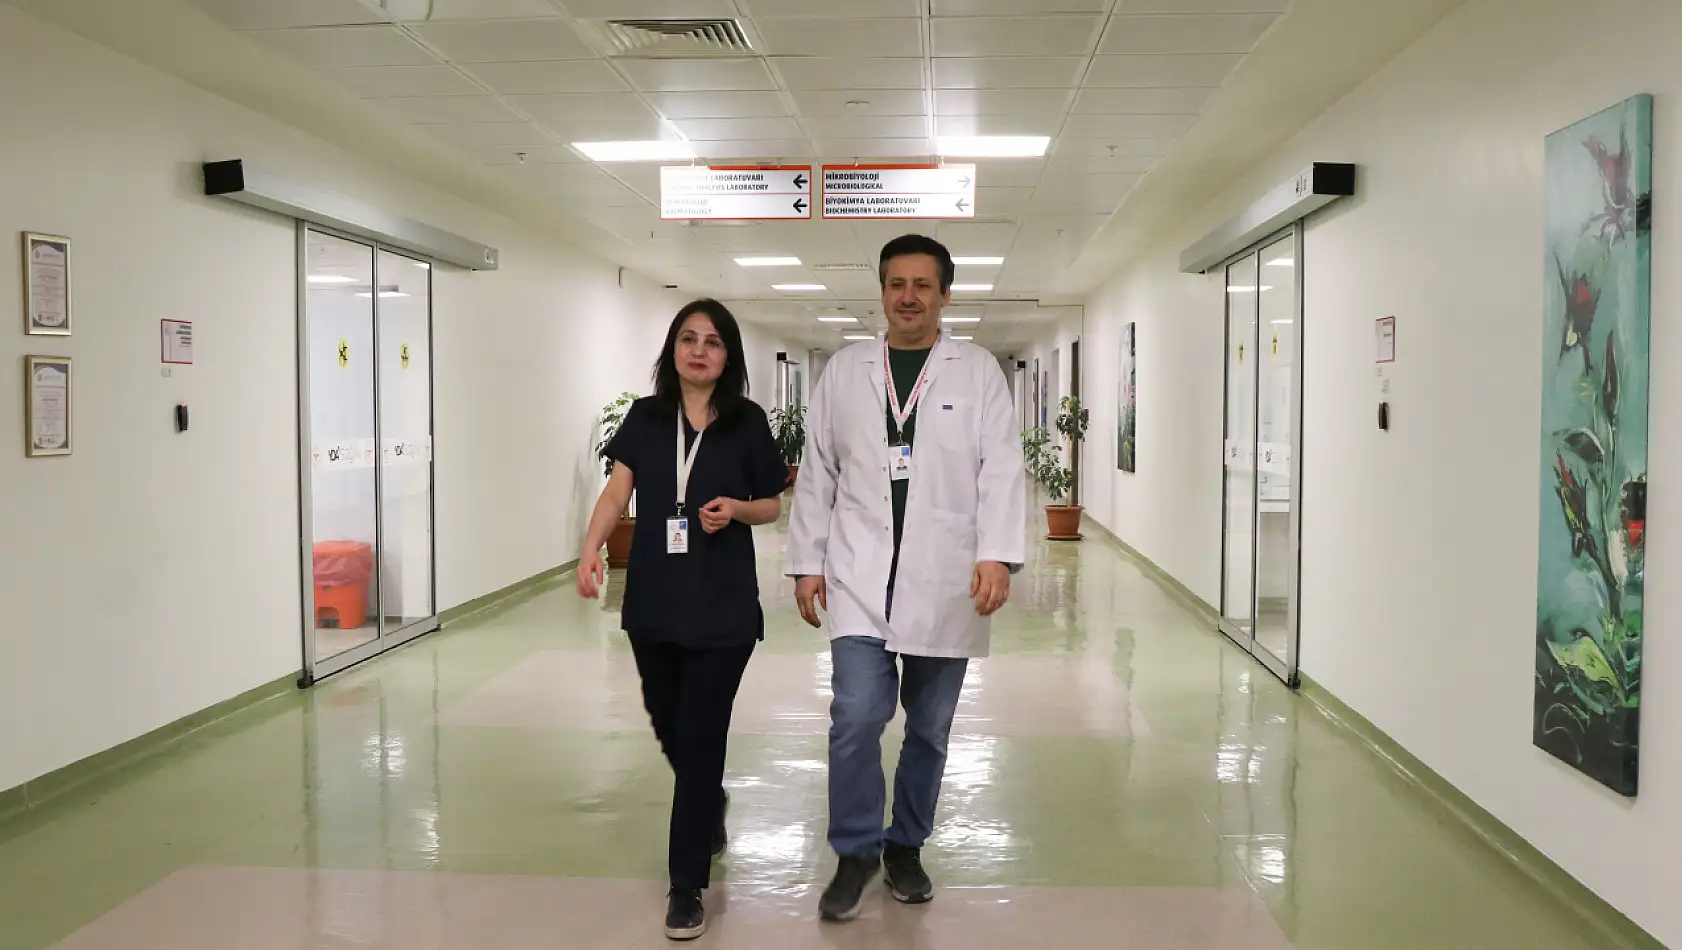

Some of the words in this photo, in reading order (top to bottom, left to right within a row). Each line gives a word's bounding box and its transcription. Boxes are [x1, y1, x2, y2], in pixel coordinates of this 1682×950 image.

[825, 172, 880, 181] MİKROBİYOLOJİ
[825, 182, 884, 190] MICROBIOLOGICAL
[825, 196, 865, 204] BİYOKİMYA
[873, 207, 916, 215] LABORATORY
